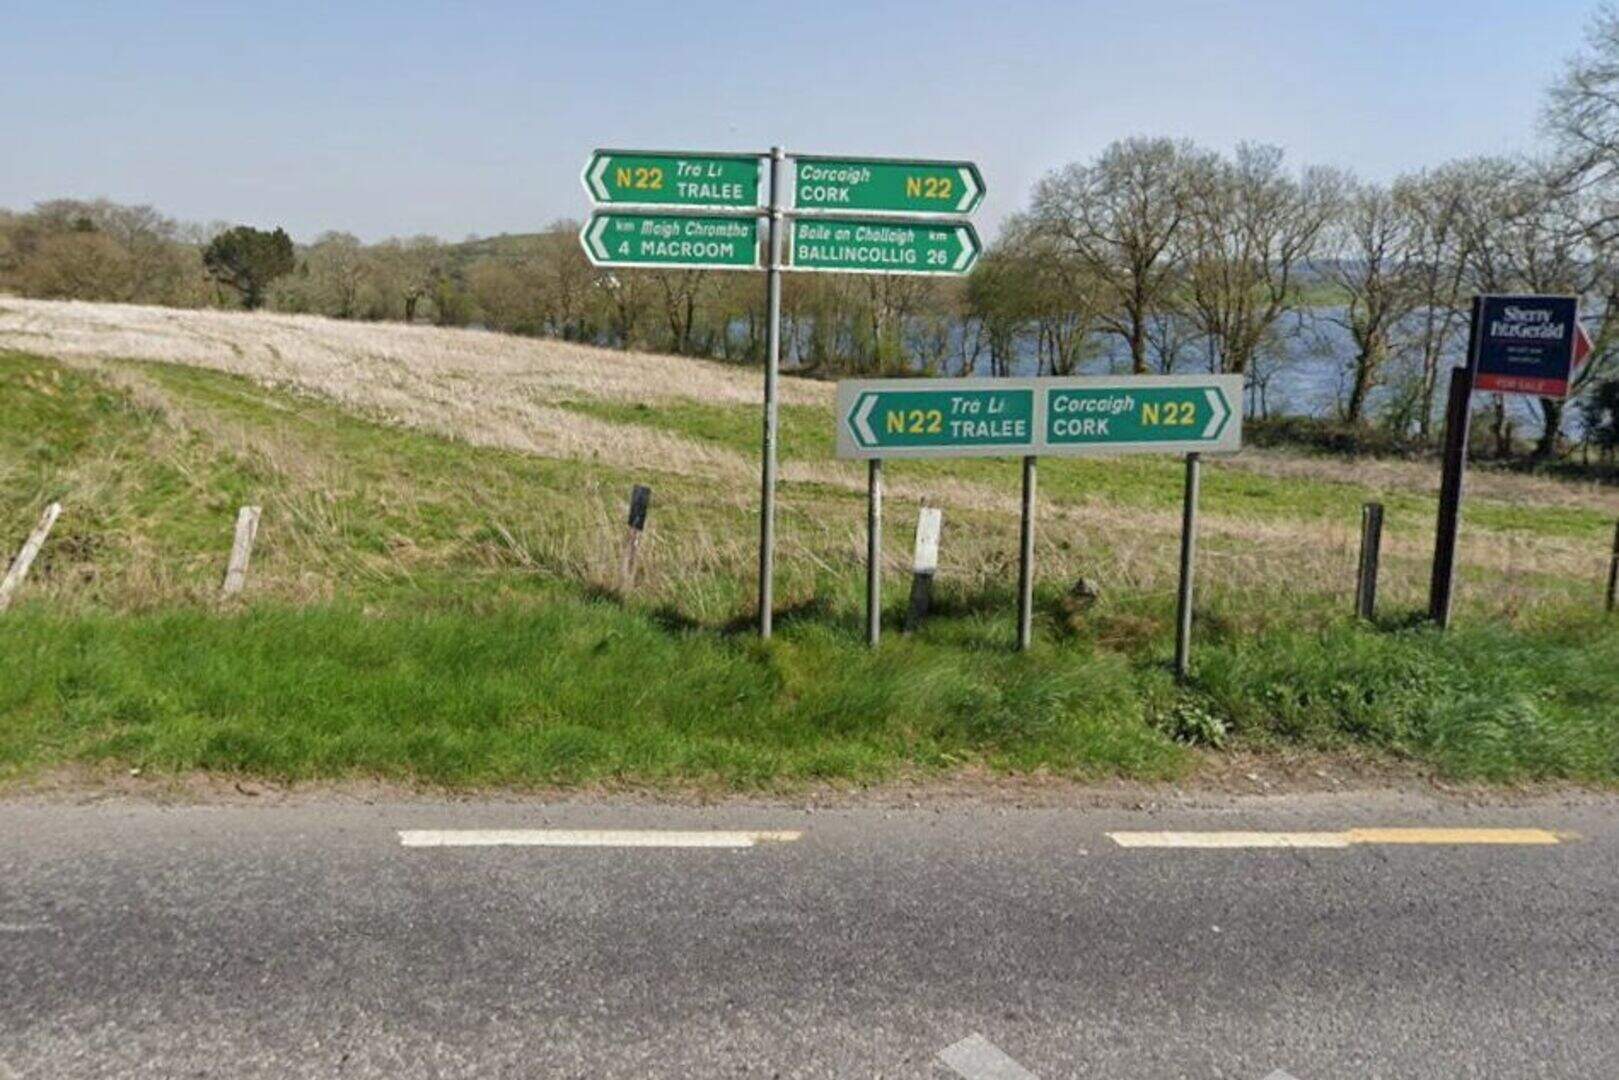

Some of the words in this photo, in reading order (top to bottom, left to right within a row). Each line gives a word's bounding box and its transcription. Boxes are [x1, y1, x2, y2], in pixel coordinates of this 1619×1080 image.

[616, 167, 664, 190] N22
[800, 165, 872, 183] Corcaigh
[676, 182, 744, 199] TRALEE
[800, 186, 850, 202] CORK
[906, 177, 953, 199] N22
[615, 220, 635, 232] km
[928, 231, 948, 242] km
[618, 242, 631, 256] 4
[640, 241, 735, 258] MACROOM
[798, 245, 917, 263] BALLINCOLLIG
[926, 249, 948, 265] 26
[1053, 394, 1136, 416] Corcaigh
[1140, 401, 1196, 426] N22
[886, 409, 943, 434] N22
[950, 419, 1027, 439] TRALEE
[1053, 418, 1110, 437] CORK
